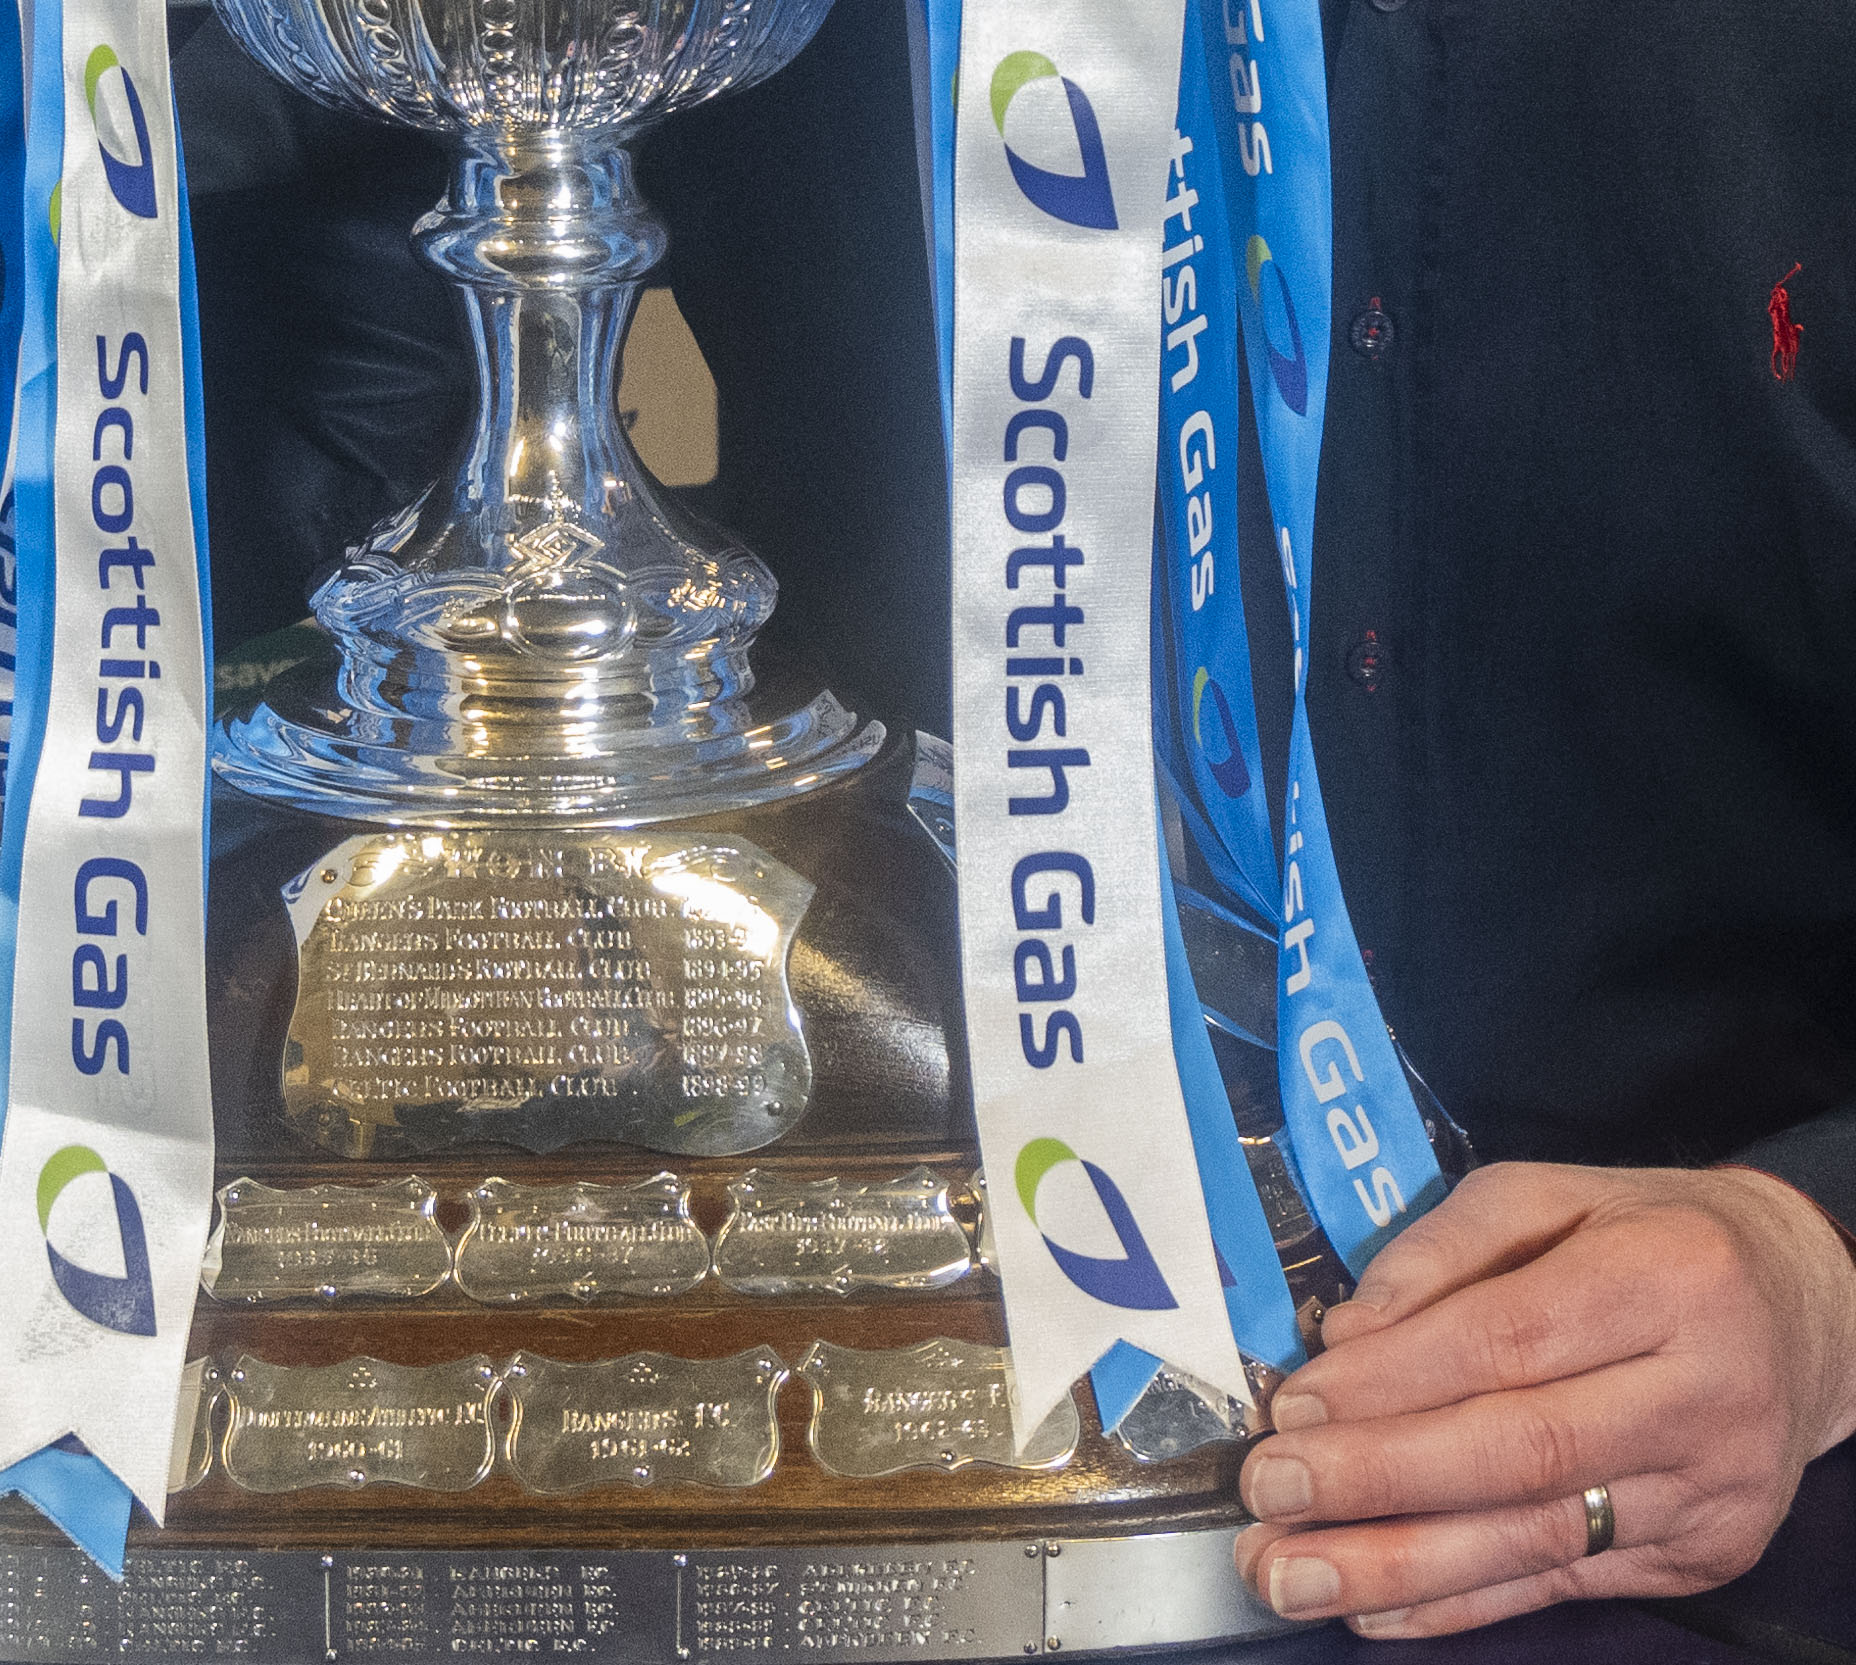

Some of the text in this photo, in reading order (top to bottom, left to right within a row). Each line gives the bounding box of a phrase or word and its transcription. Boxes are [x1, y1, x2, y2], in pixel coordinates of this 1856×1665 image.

[71, 331, 162, 1077] Scottish Gas
[1003, 334, 1097, 1071] Scottish Gas
[1178, 408, 1216, 613] Gas
[1298, 1018, 1406, 1229] Gas
